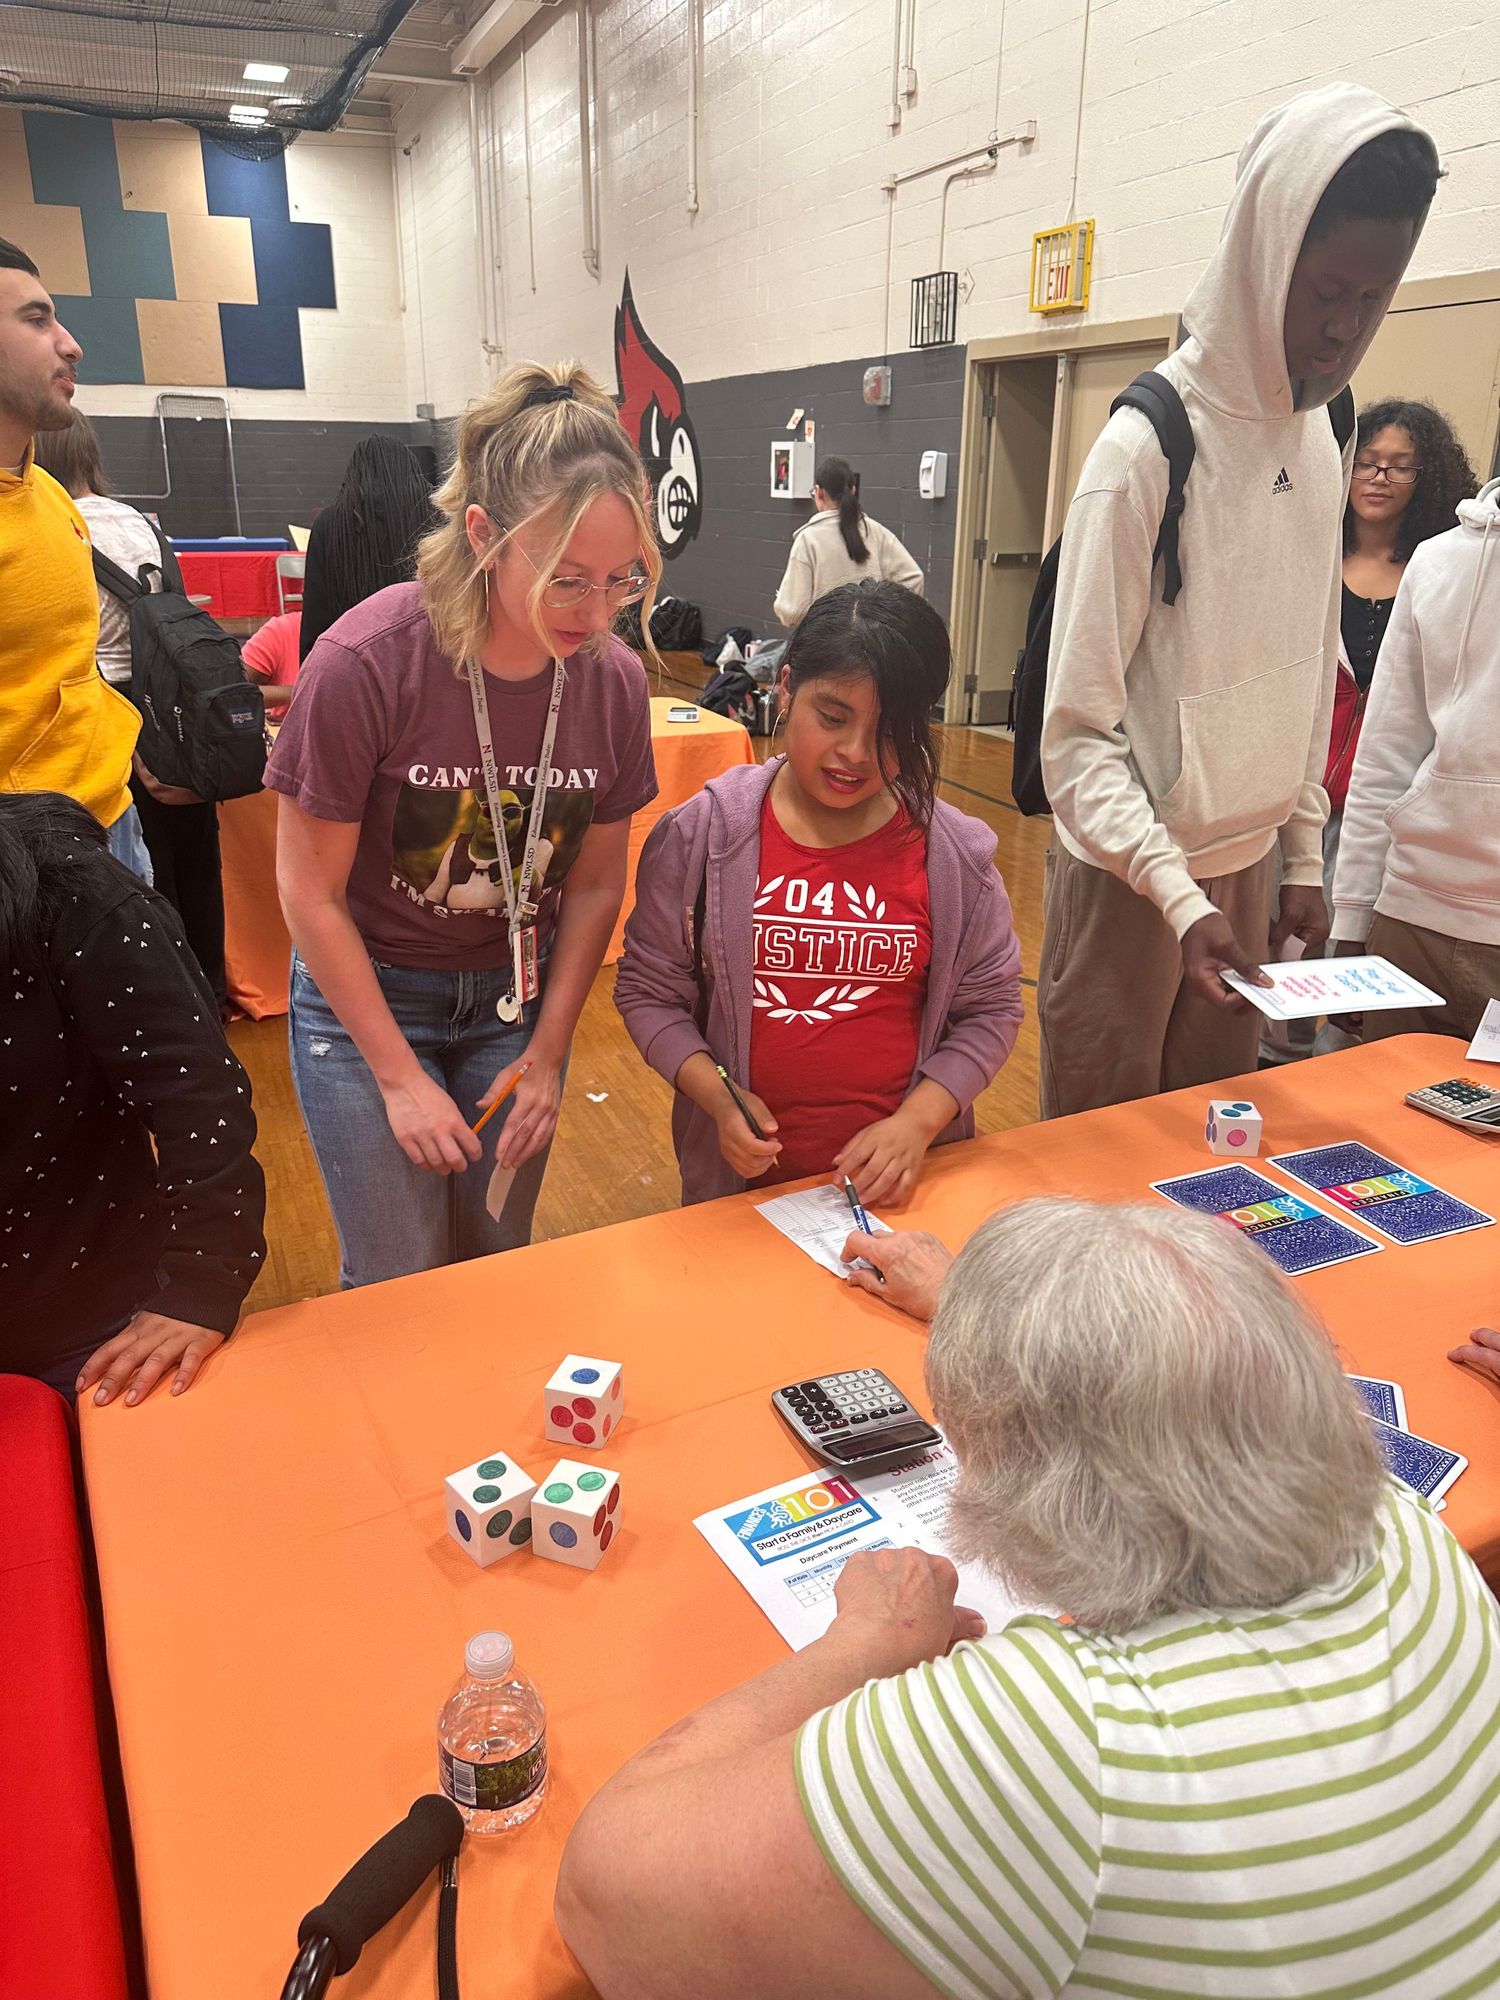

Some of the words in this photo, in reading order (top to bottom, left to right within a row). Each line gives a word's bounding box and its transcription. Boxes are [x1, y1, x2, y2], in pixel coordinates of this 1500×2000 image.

[485, 759, 496, 792] NWLSD
[506, 766, 598, 789] TODAY
[524, 847, 535, 880] NWLSD
[390, 875, 424, 907] I'M
[785, 879, 834, 916] 04
[753, 924, 917, 976] STICE
[1352, 1190, 1407, 1206] FINANCES
[1244, 1216, 1292, 1233] FINANCE
[888, 1451, 943, 1476] Station
[785, 1480, 853, 1517] 101
[756, 1538, 779, 1551] Start
[786, 1524, 816, 1539] Family
[815, 1521, 823, 1530] &
[824, 1507, 862, 1526] Daycare
[800, 1549, 828, 1564] Daycare
[828, 1537, 858, 1552] Payment
